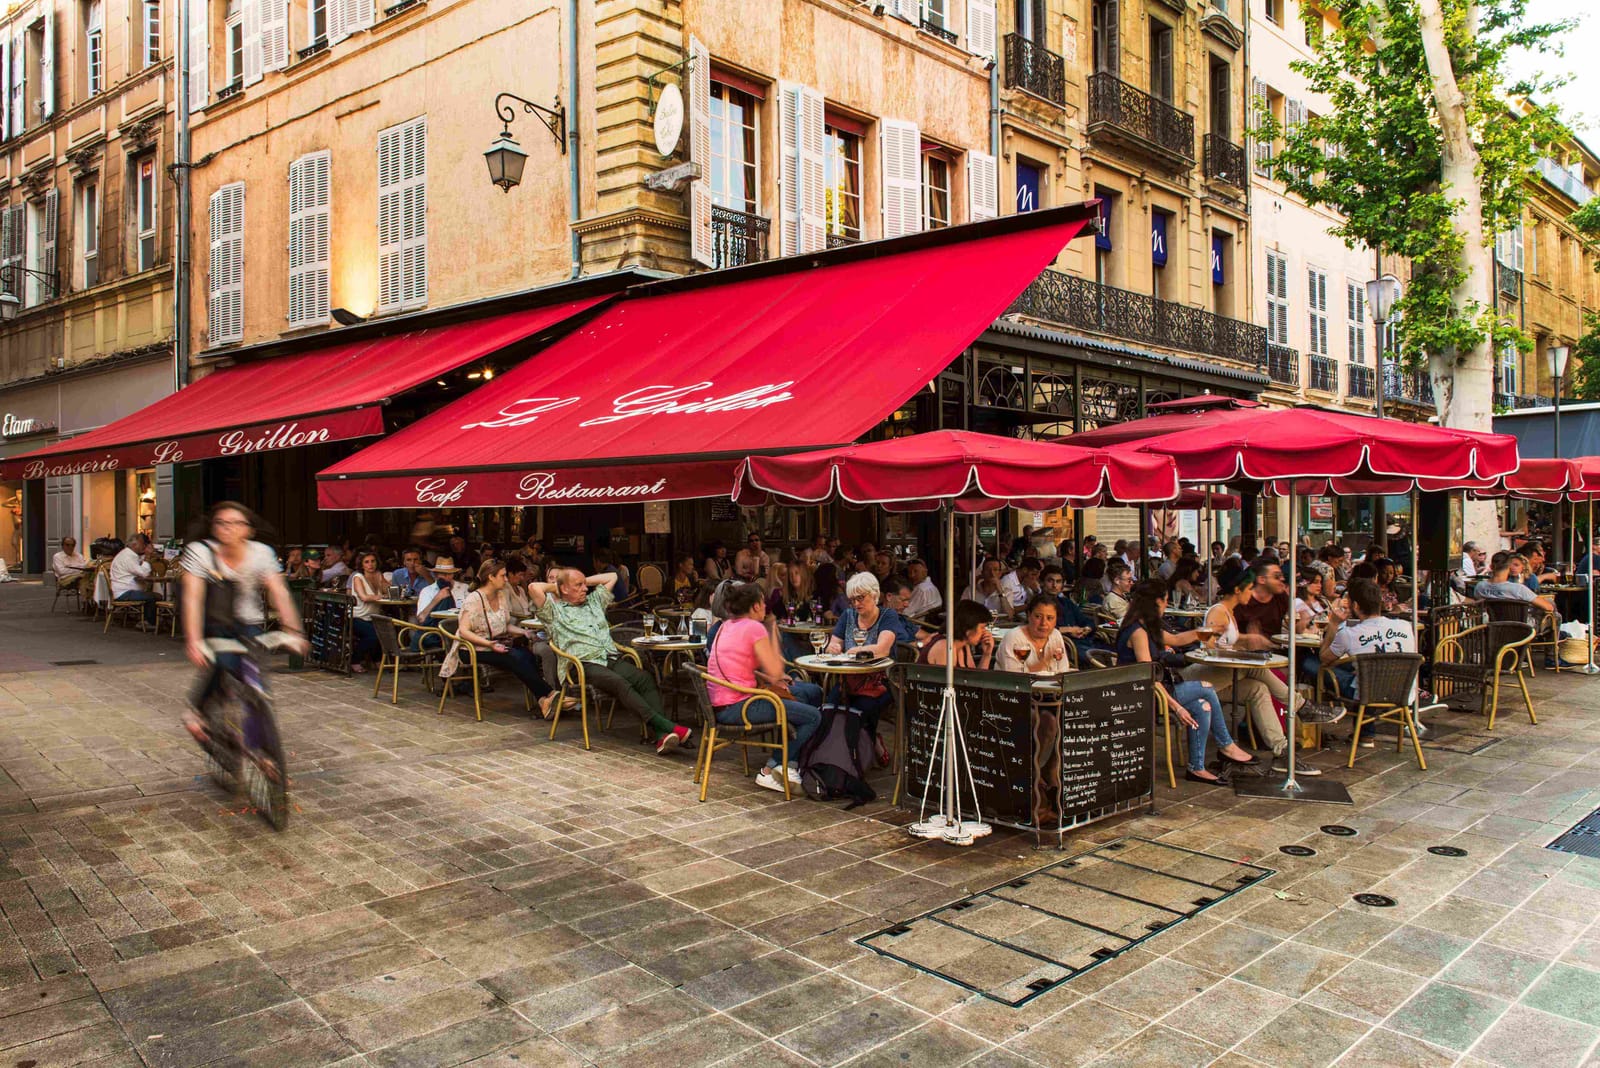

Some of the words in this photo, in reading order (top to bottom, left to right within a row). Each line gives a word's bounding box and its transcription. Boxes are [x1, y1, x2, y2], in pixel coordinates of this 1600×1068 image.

[2, 412, 34, 437] Etam
[460, 396, 581, 430] Le
[22, 454, 120, 481] Brasserie
[150, 440, 184, 466] Le
[219, 422, 331, 456] Grillon
[415, 477, 469, 509] Café
[514, 471, 668, 501] Restaurant
[1359, 631, 1383, 647] Surf
[1386, 628, 1409, 640] Crew
